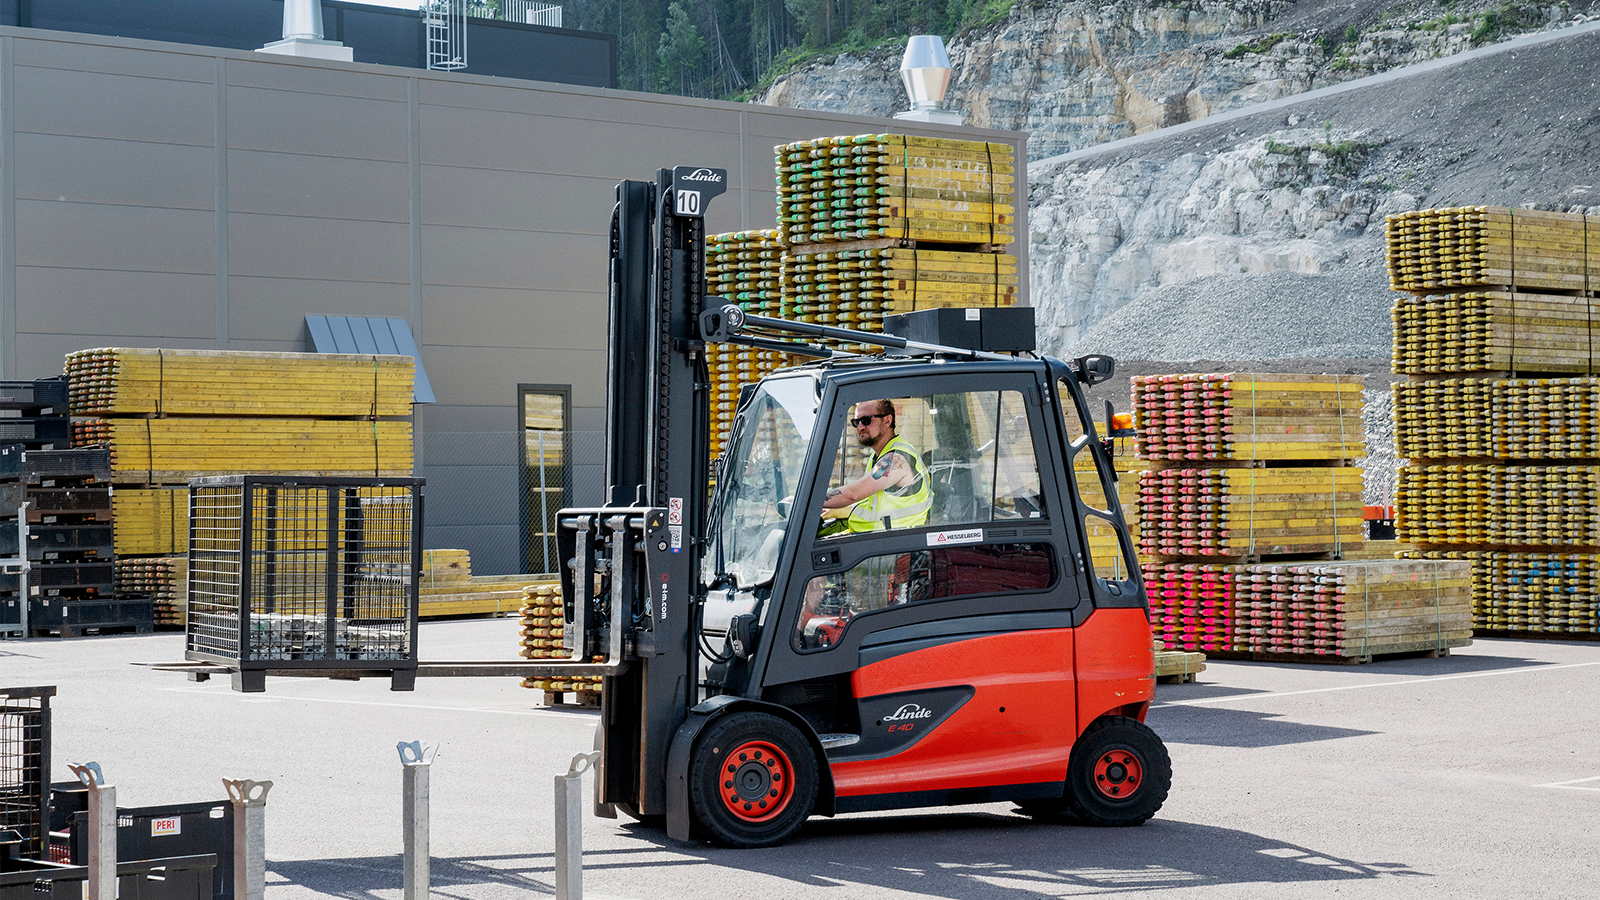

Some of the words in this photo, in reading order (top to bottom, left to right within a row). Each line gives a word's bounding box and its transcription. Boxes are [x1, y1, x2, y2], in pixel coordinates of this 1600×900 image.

[681, 168, 722, 182] Linde
[679, 192, 698, 213] 10
[947, 532, 981, 540] HESSELBERG
[883, 703, 932, 721] Linde
[887, 724, 897, 732] E
[897, 723, 914, 731] 40
[156, 820, 175, 830] PERI
